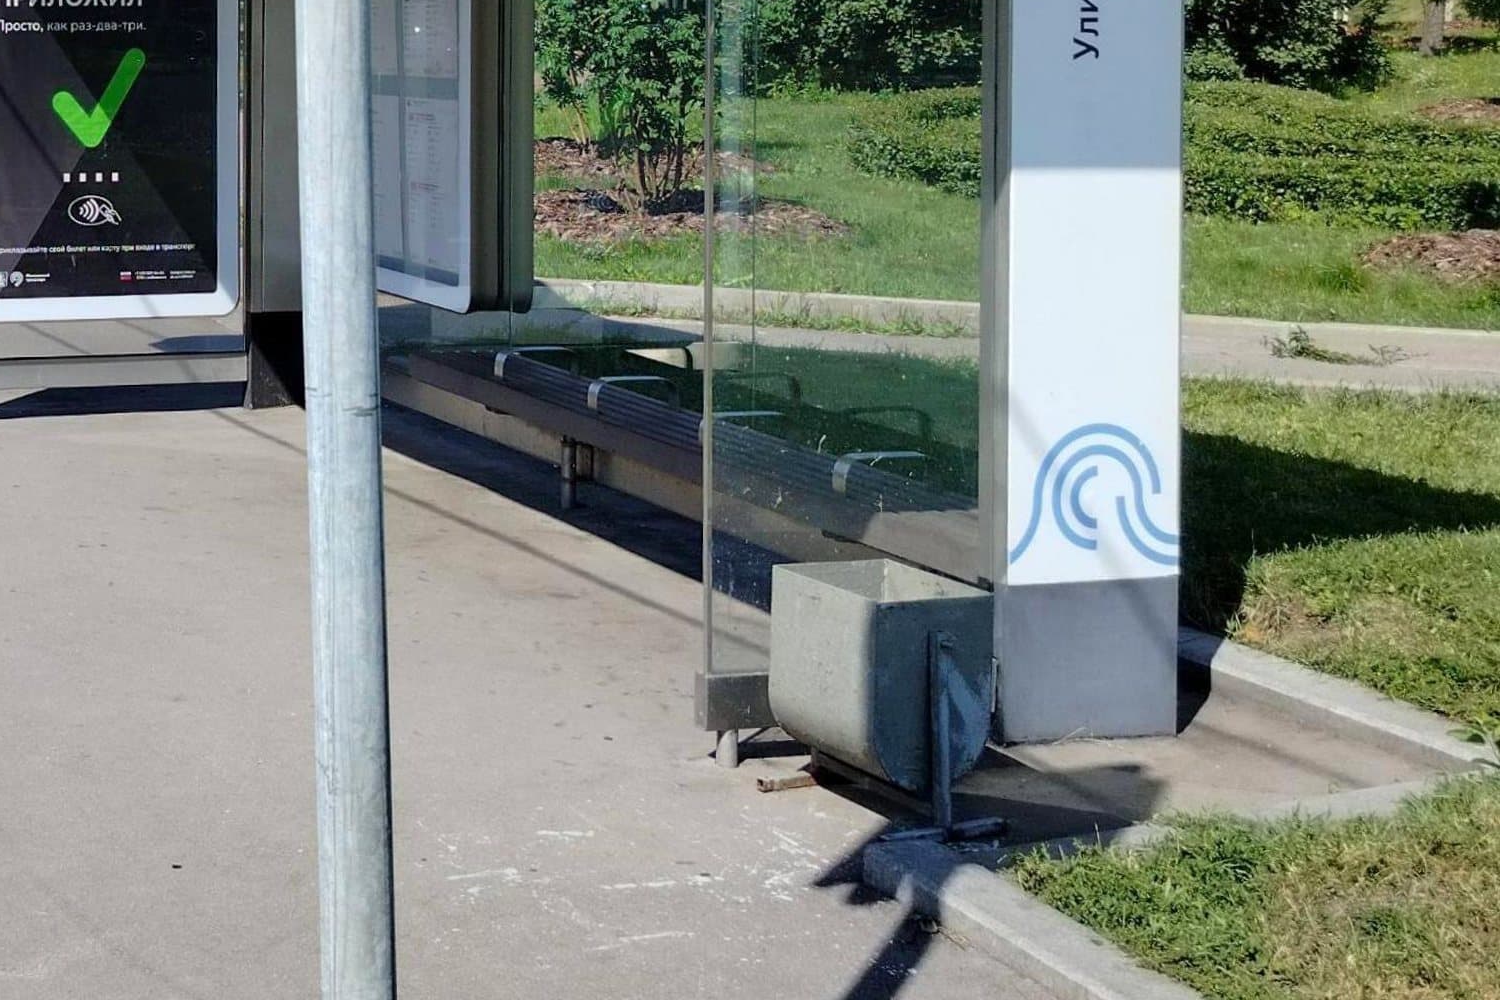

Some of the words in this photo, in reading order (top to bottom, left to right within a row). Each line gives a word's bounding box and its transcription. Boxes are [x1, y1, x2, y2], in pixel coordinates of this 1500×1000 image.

[47, 21, 67, 31] как
[70, 21, 147, 33] раз-два-три.
[66, 245, 86, 253] билет
[161, 243, 196, 252] транспорт
